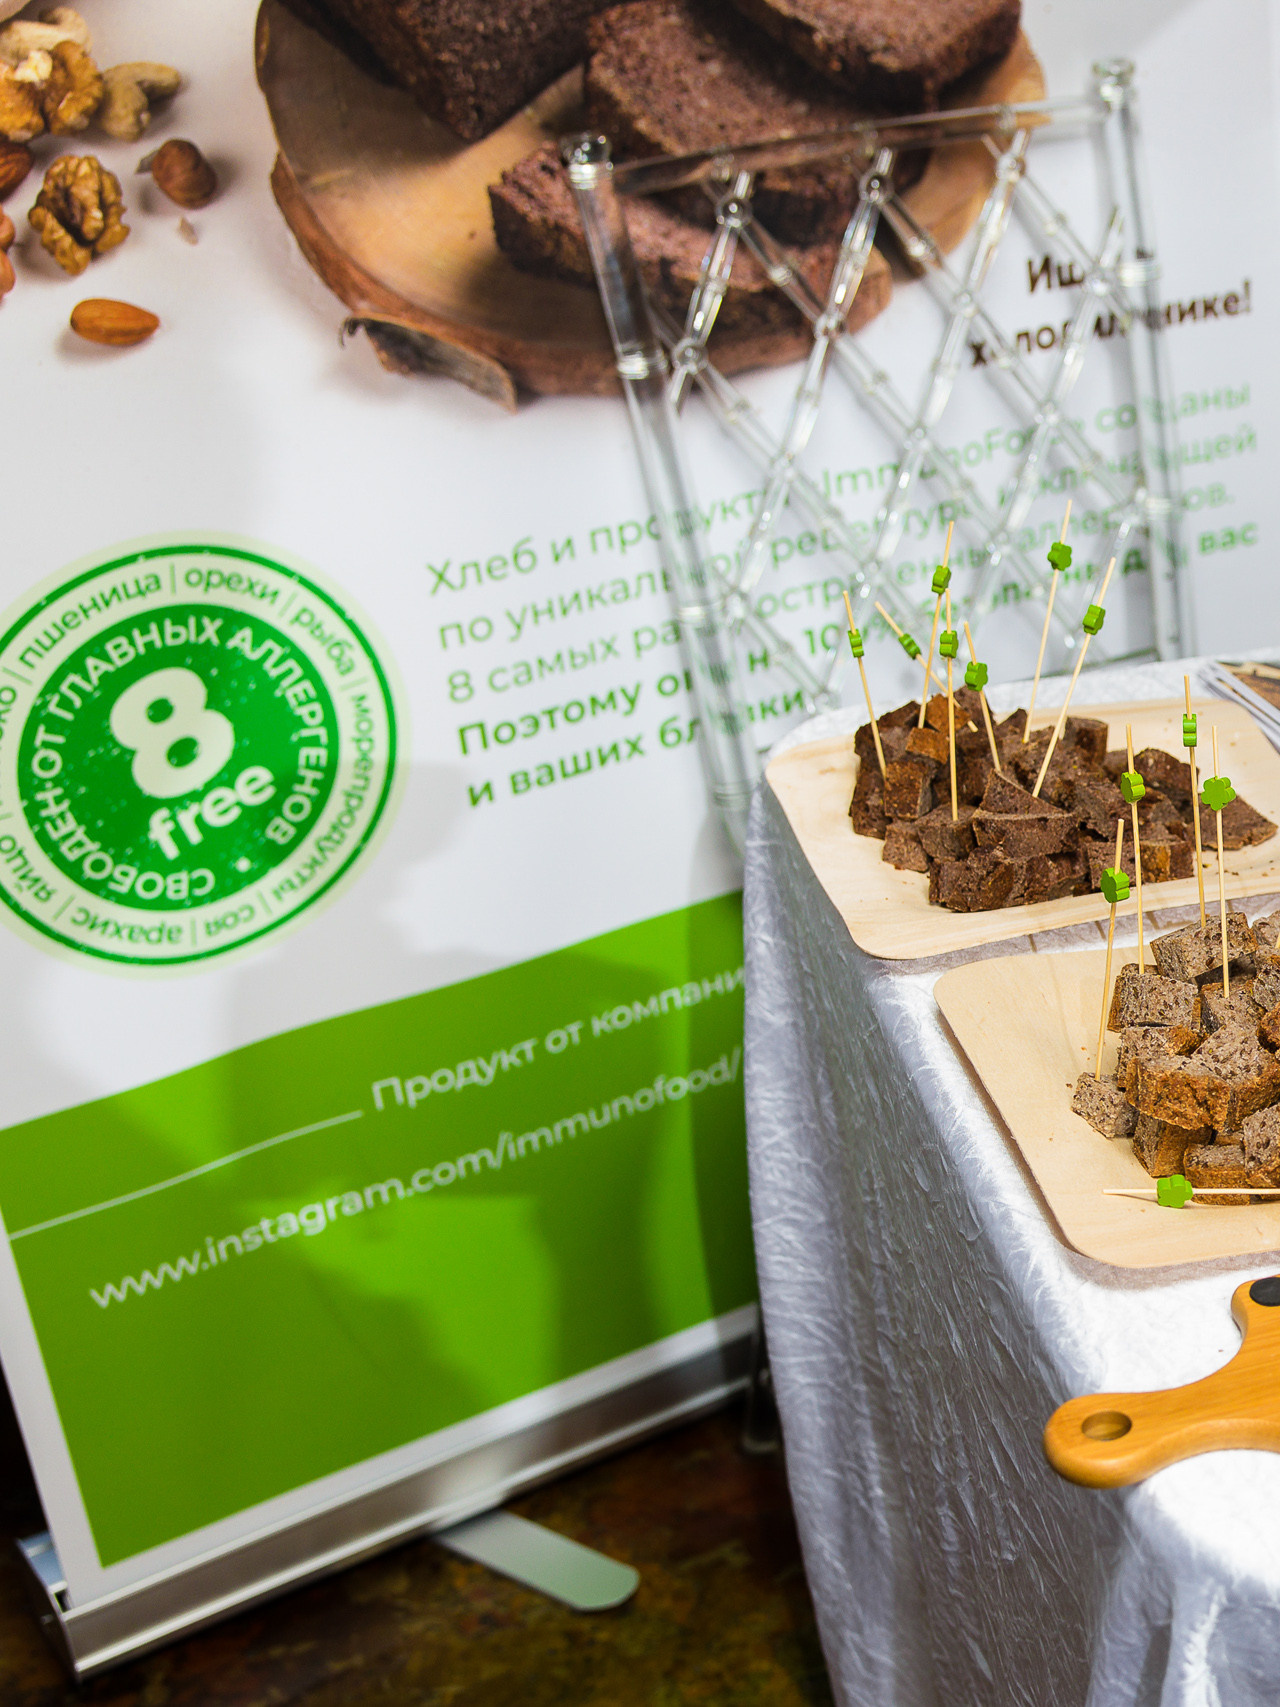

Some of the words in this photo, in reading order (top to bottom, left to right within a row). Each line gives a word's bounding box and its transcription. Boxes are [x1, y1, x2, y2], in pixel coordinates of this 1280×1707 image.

[184, 566, 282, 606] орехи
[427, 537, 538, 596] Хлеб
[551, 535, 576, 564] и
[17, 571, 163, 671] пшеница
[46, 614, 223, 723] ГЛАВНЫХ
[289, 604, 357, 679] рыба
[439, 614, 494, 650] по
[447, 669, 475, 704] 8
[487, 635, 619, 693] самых
[458, 679, 642, 757] Поэтому
[1199, 522, 1260, 557] вас
[30, 723, 67, 780] ОТ
[109, 666, 236, 800] 8
[227, 626, 330, 847] АЛЛЕРГЕНОВ
[468, 779, 495, 808] и
[510, 733, 647, 796] ваших
[33, 785, 217, 901] СВОБОДЕН
[147, 765, 278, 862] free
[272, 692, 376, 902] морепродукты
[71, 903, 184, 947] арахис
[203, 903, 257, 938] соя
[371, 1036, 538, 1112] Продукт
[544, 1019, 585, 1056] от
[591, 966, 745, 1038] компани
[88, 1046, 742, 1310] www.instagram.com/immunofood/
